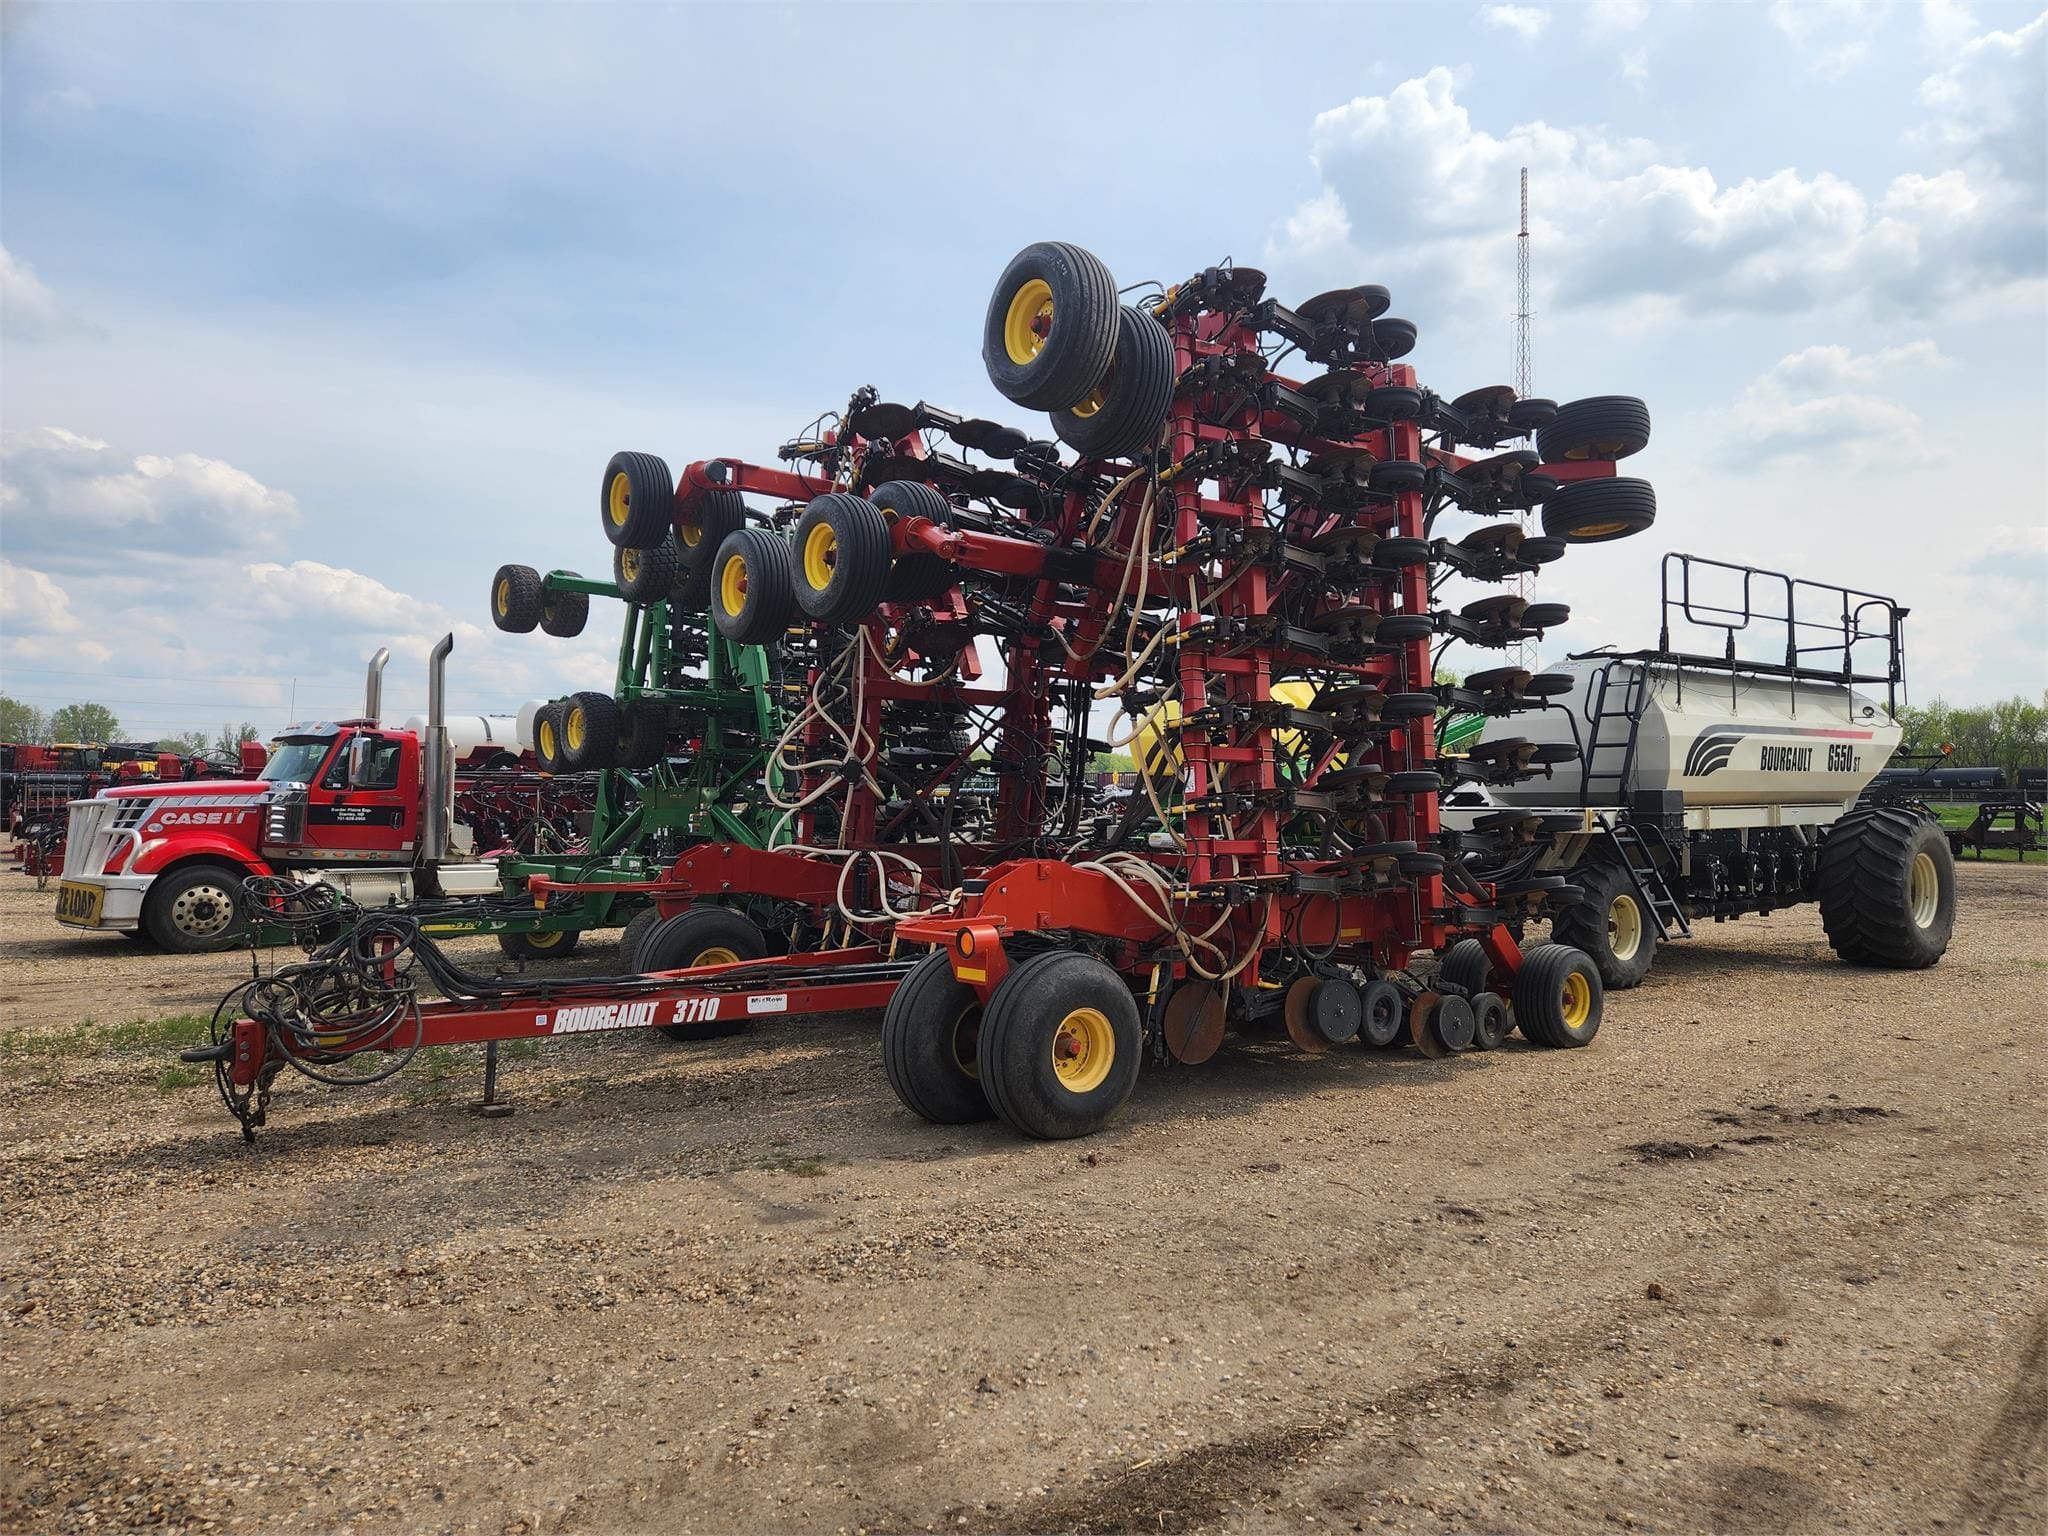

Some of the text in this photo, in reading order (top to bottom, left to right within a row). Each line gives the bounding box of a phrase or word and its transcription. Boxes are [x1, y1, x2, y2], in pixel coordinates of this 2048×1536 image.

[1760, 745, 1813, 772] BOURGAULT
[1827, 744, 1853, 772] 6550
[160, 812, 223, 825] CASE
[69, 888, 97, 919] LOAD
[552, 997, 721, 1034] BOURGAULT 3710
